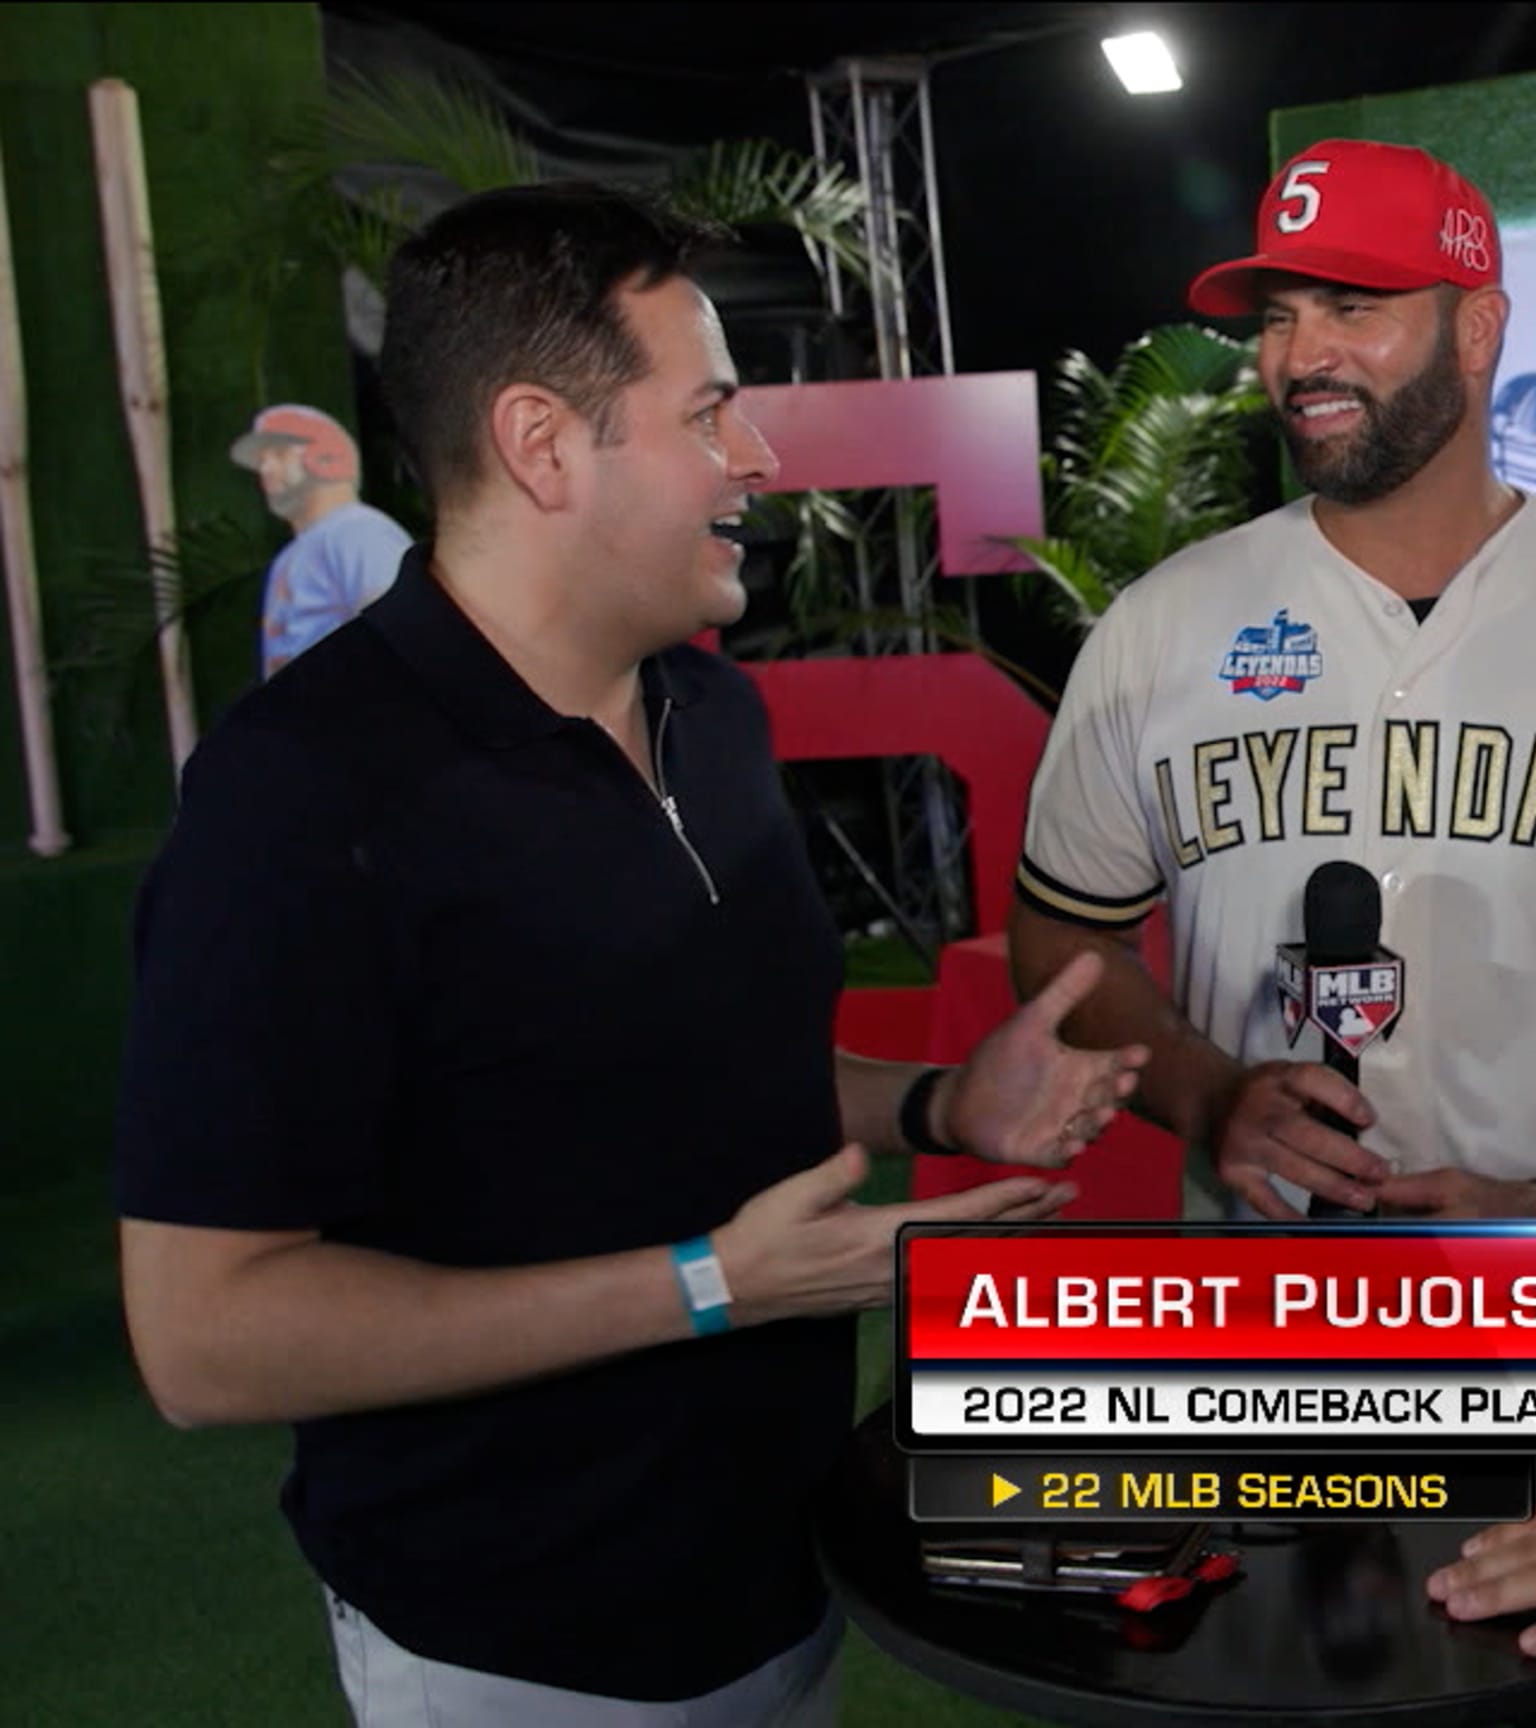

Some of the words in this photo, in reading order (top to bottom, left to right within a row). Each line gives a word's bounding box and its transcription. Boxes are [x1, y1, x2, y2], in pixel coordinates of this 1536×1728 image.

[1277, 160, 1331, 233] 5
[1222, 653, 1322, 677] LEYENDAS
[1319, 969, 1395, 998] MLB
